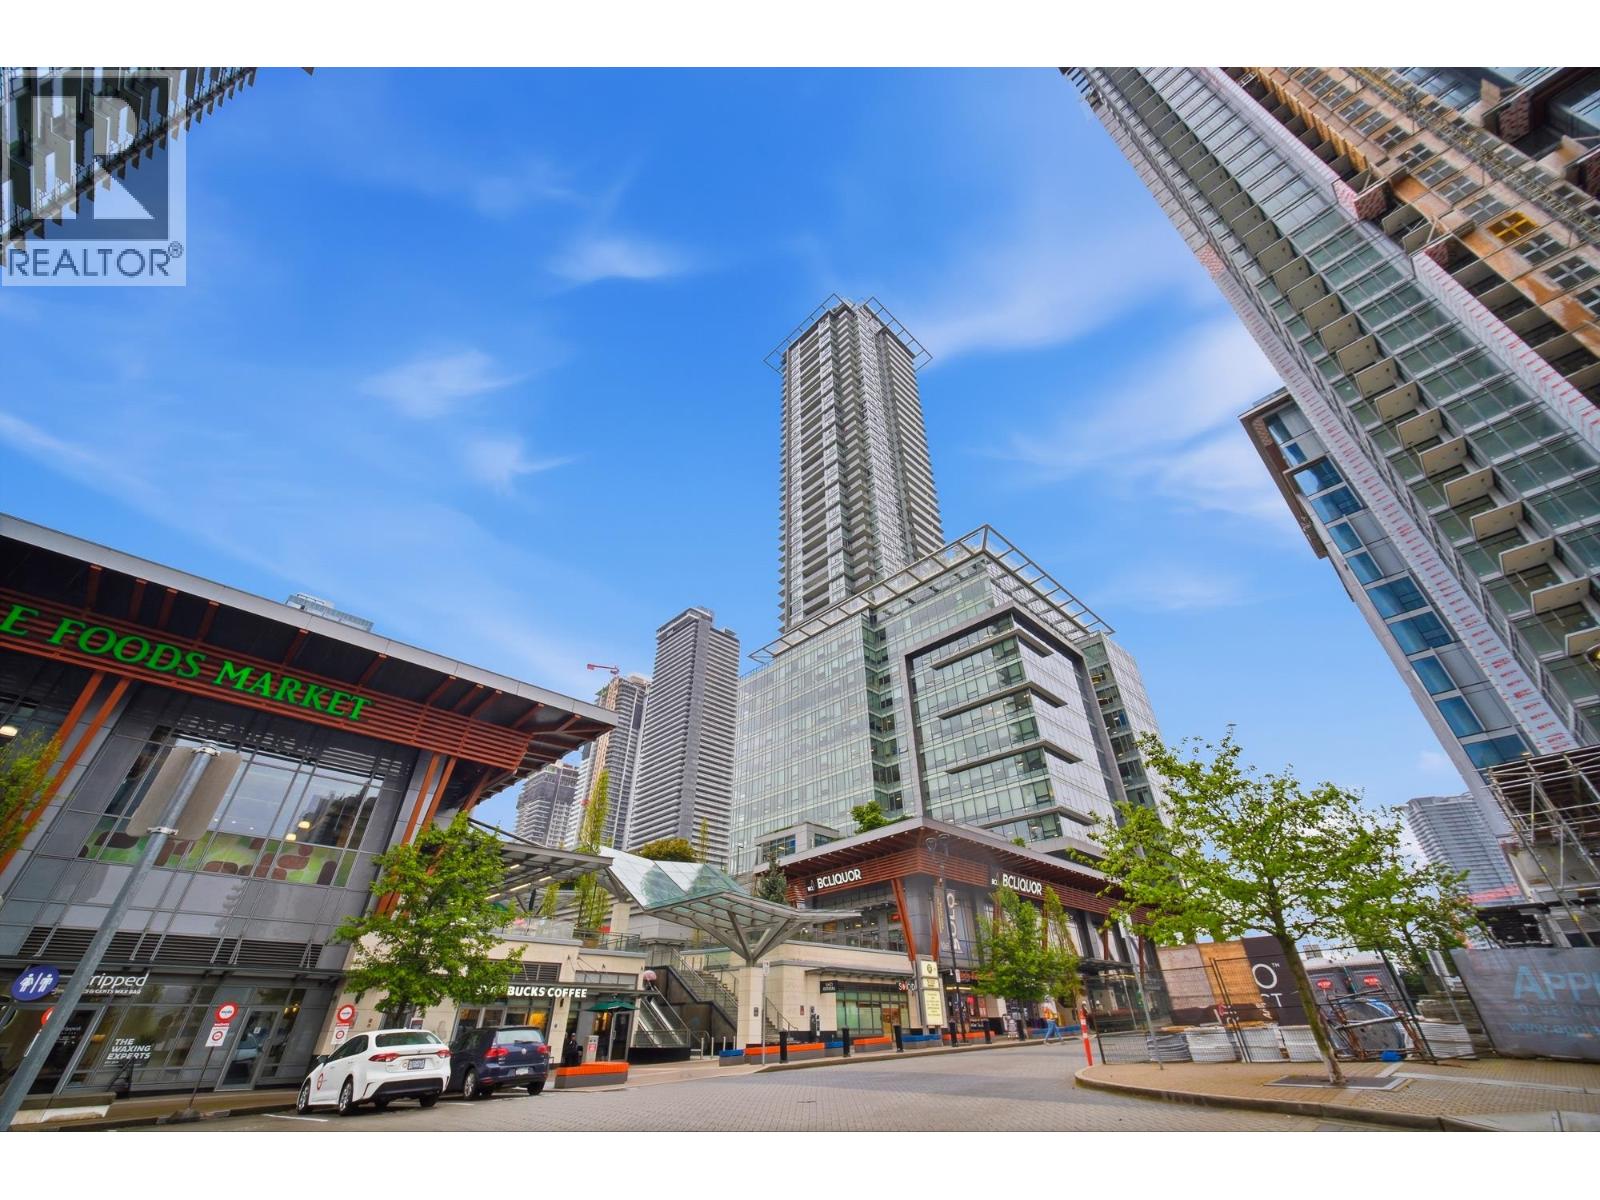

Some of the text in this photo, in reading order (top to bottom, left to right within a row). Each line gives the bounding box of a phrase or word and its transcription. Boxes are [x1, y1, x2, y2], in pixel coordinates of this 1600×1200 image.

[47, 616, 207, 678] FOODS
[213, 659, 374, 721] MARKET
[88, 969, 150, 989] ripped
[547, 987, 588, 998] COFFEE
[111, 1045, 151, 1053] WAXING
[107, 1052, 151, 1060] EXPERTS
